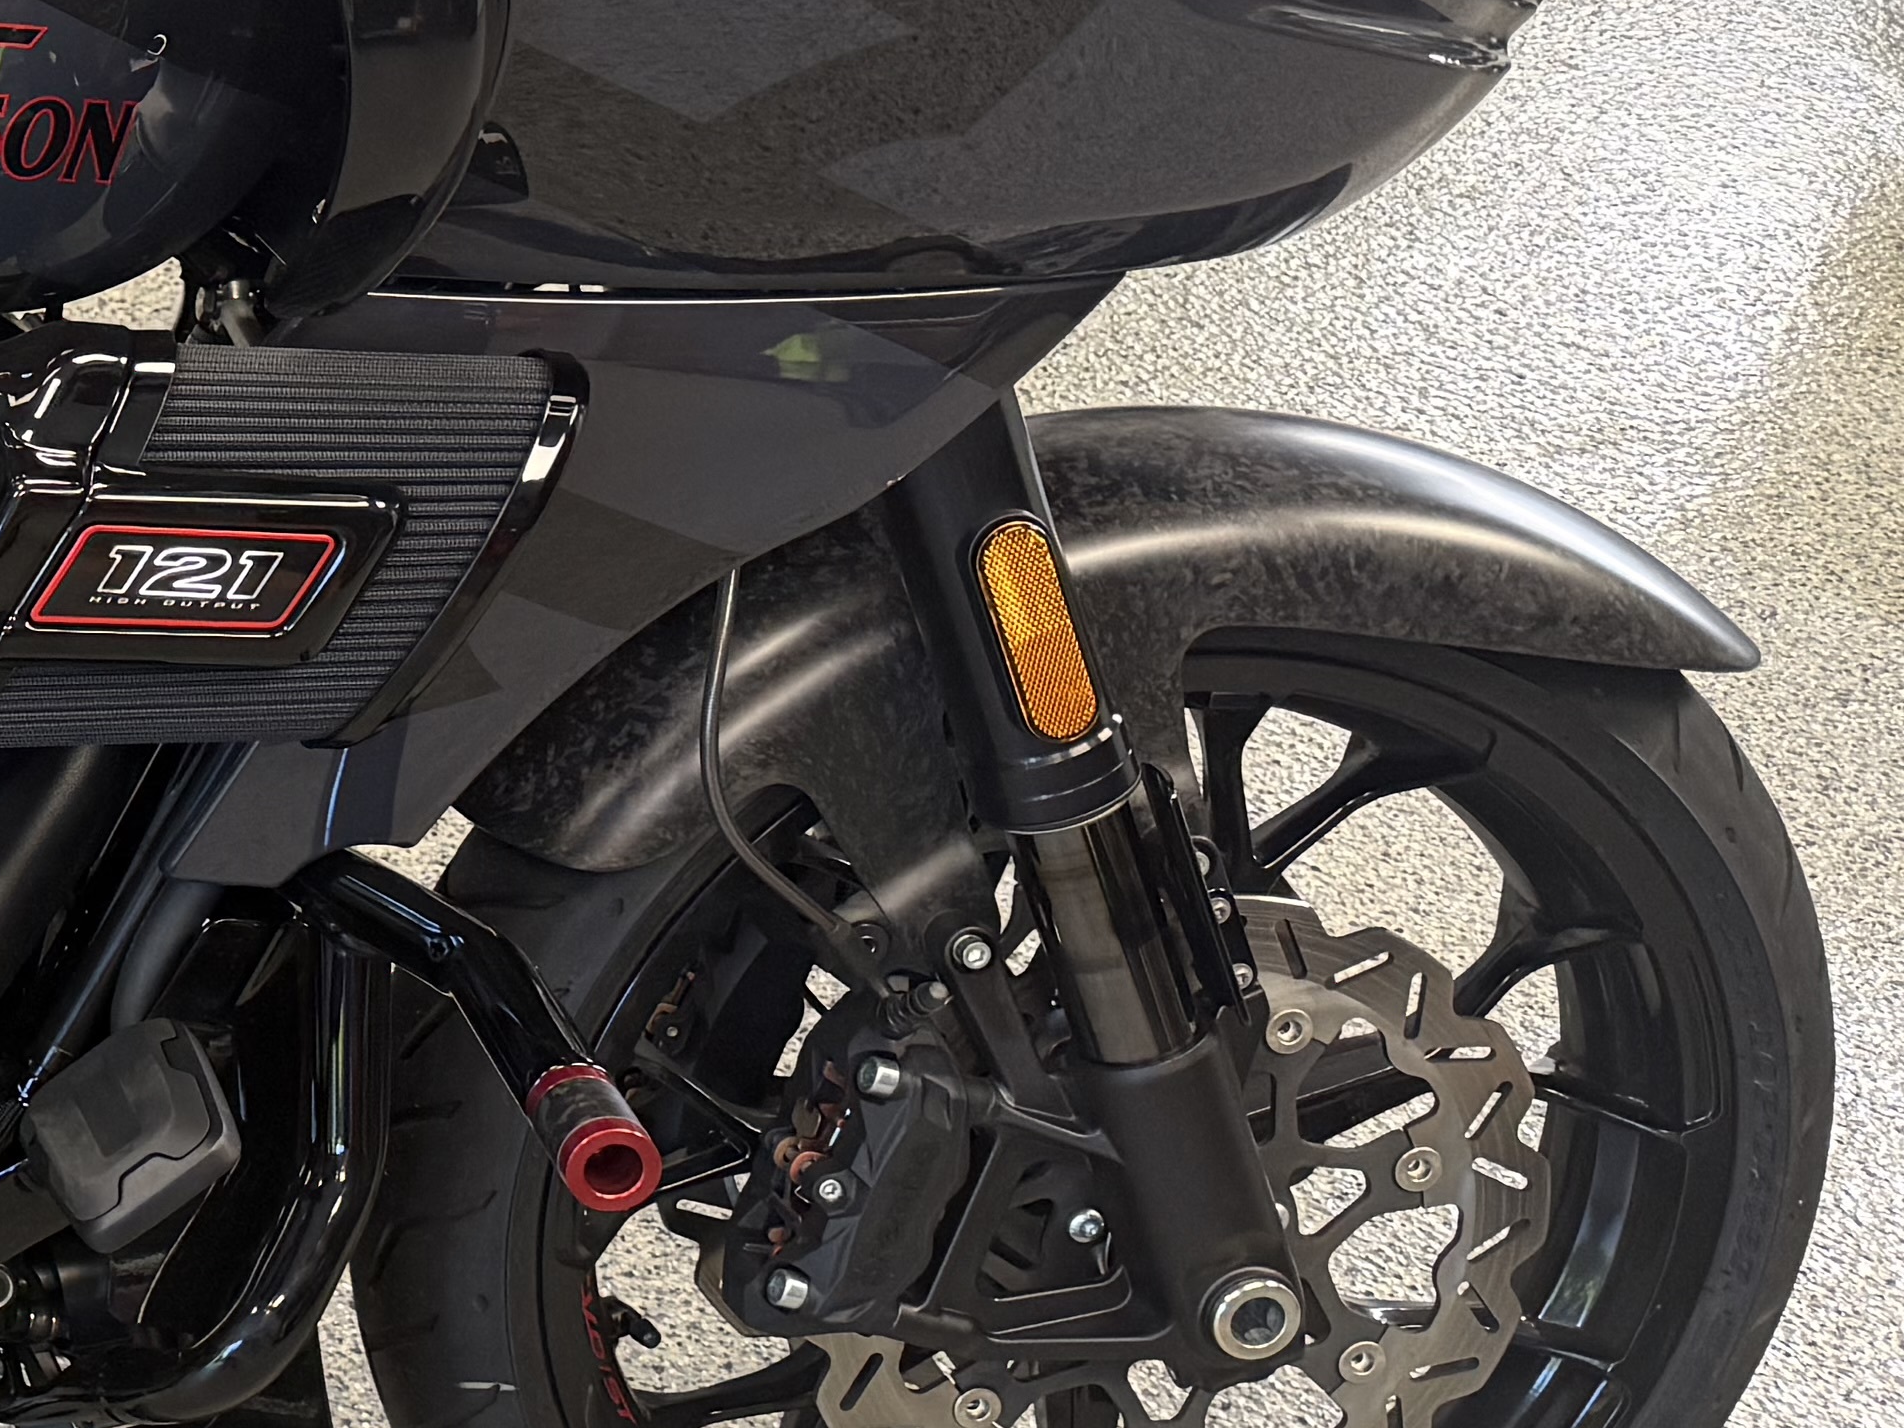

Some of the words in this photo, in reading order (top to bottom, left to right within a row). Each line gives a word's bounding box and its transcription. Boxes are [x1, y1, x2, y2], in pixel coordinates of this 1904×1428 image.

[96, 545, 285, 599] 121
[89, 596, 147, 606] HIGH
[162, 599, 261, 611] OUTPUT
